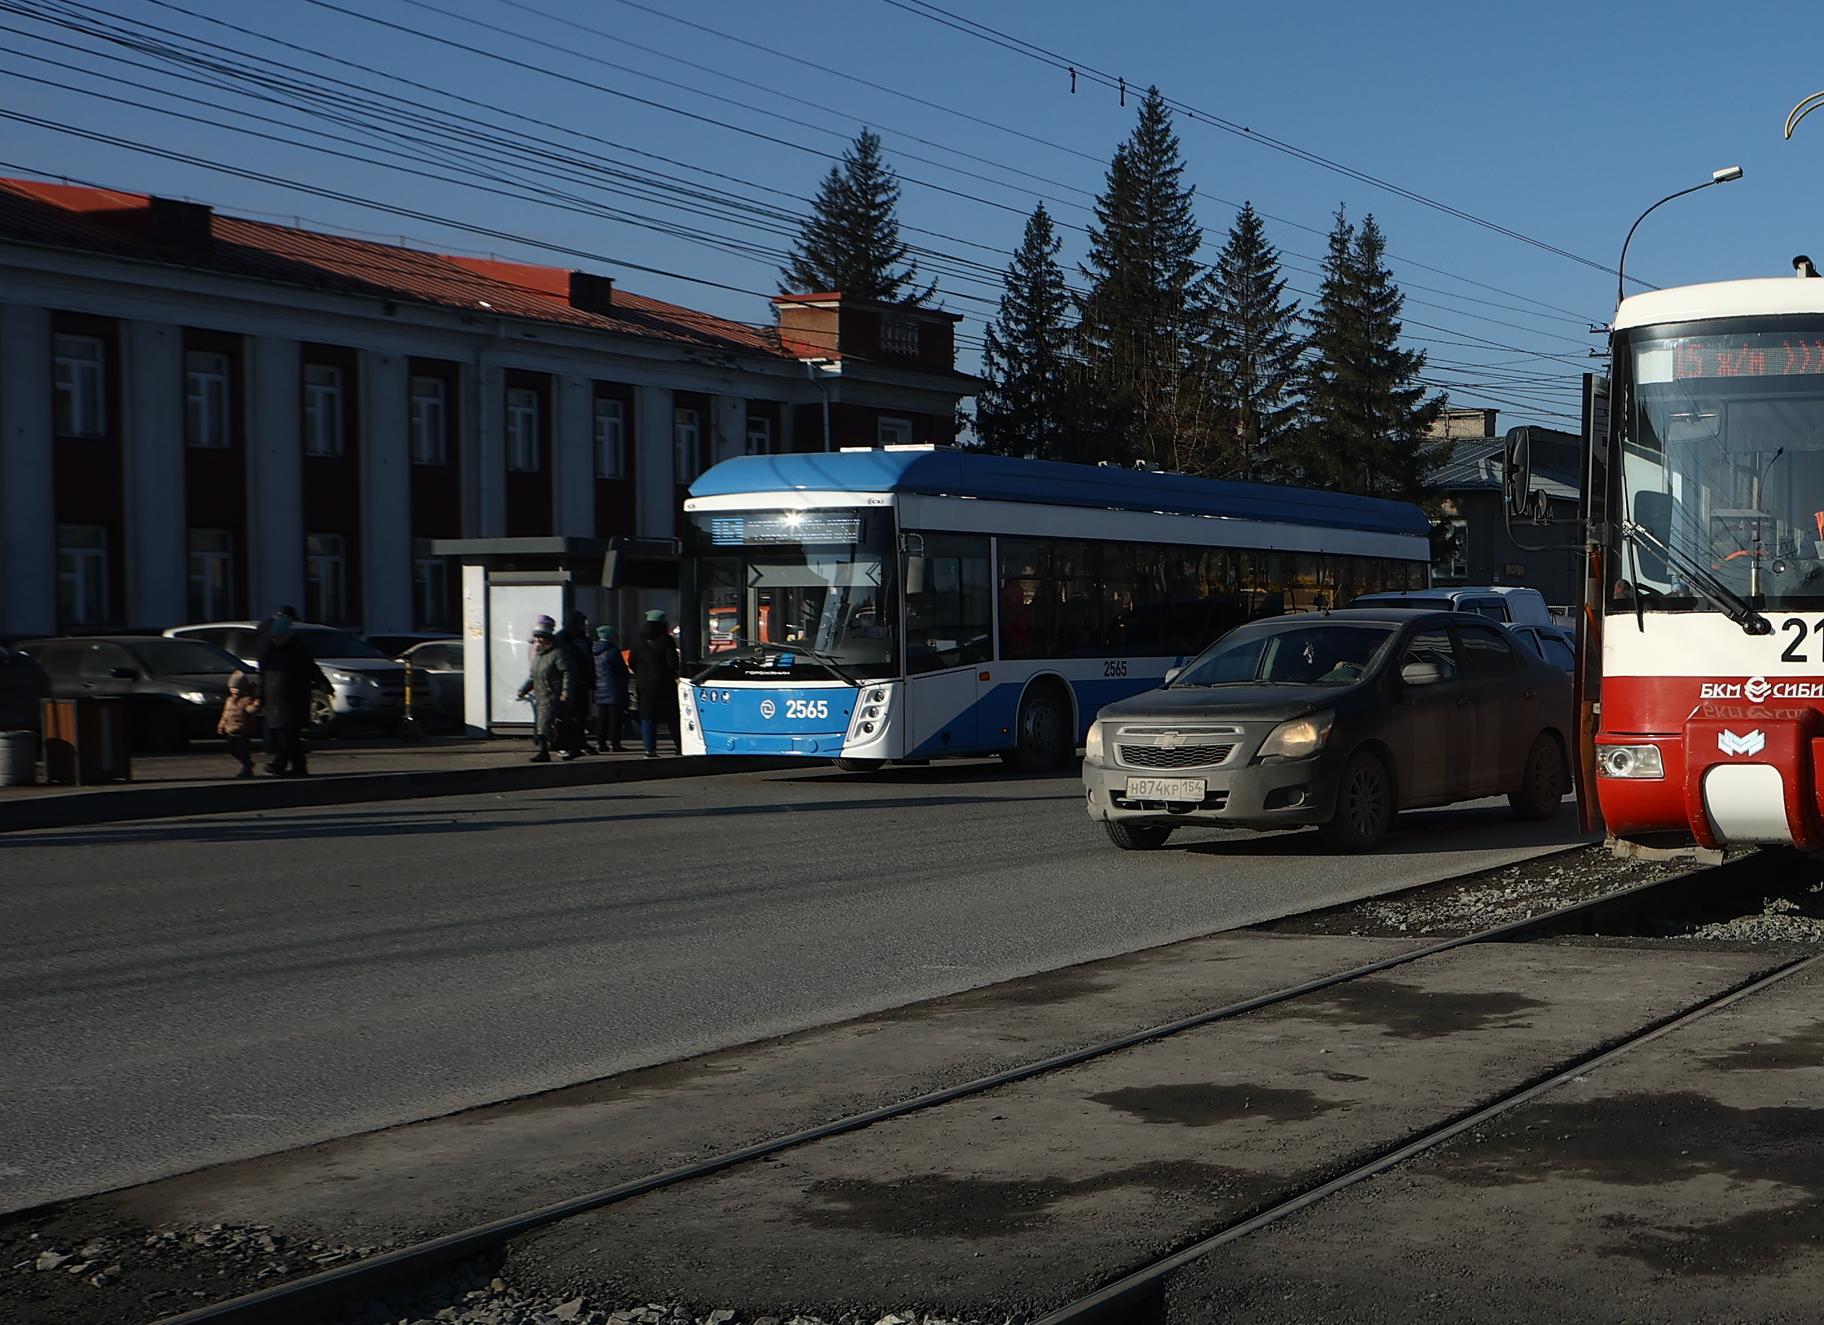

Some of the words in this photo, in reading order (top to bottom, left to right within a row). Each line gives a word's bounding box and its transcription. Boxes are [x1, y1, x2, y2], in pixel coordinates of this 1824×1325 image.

[1103, 660, 1128, 677] 2565
[1700, 682, 1742, 699] БКМ
[785, 700, 829, 719] 2565
[1130, 780, 1180, 796] Н874КР
[1182, 780, 1203, 793] 154
